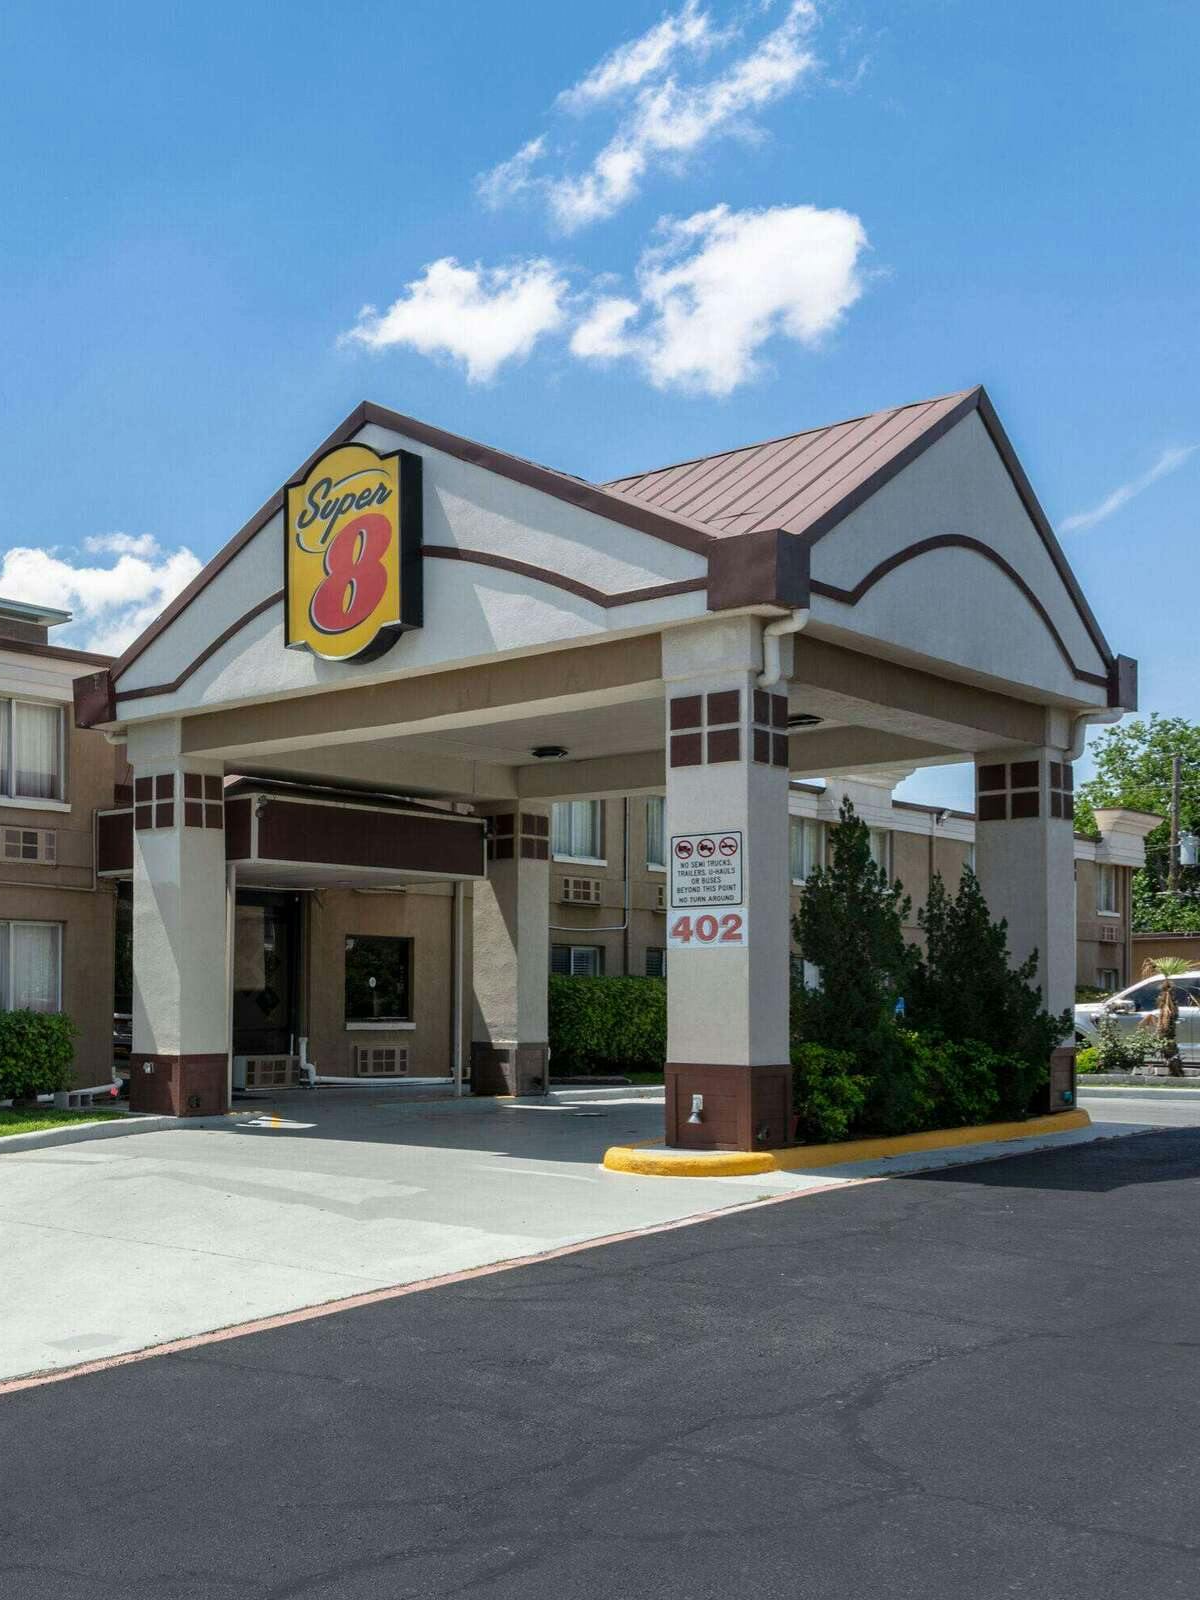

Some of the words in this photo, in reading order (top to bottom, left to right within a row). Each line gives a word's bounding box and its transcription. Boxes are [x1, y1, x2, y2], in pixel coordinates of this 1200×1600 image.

[298, 476, 393, 545] Super
[308, 513, 392, 635] 8
[690, 860, 705, 868] SEMI
[708, 867, 736, 875] U-HAULS
[701, 876, 722, 884] BUSES
[676, 886, 701, 894] BEYOND
[703, 885, 717, 893] THIS
[717, 883, 737, 892] POINT
[708, 894, 735, 902] AROUND
[671, 914, 743, 943] 402
